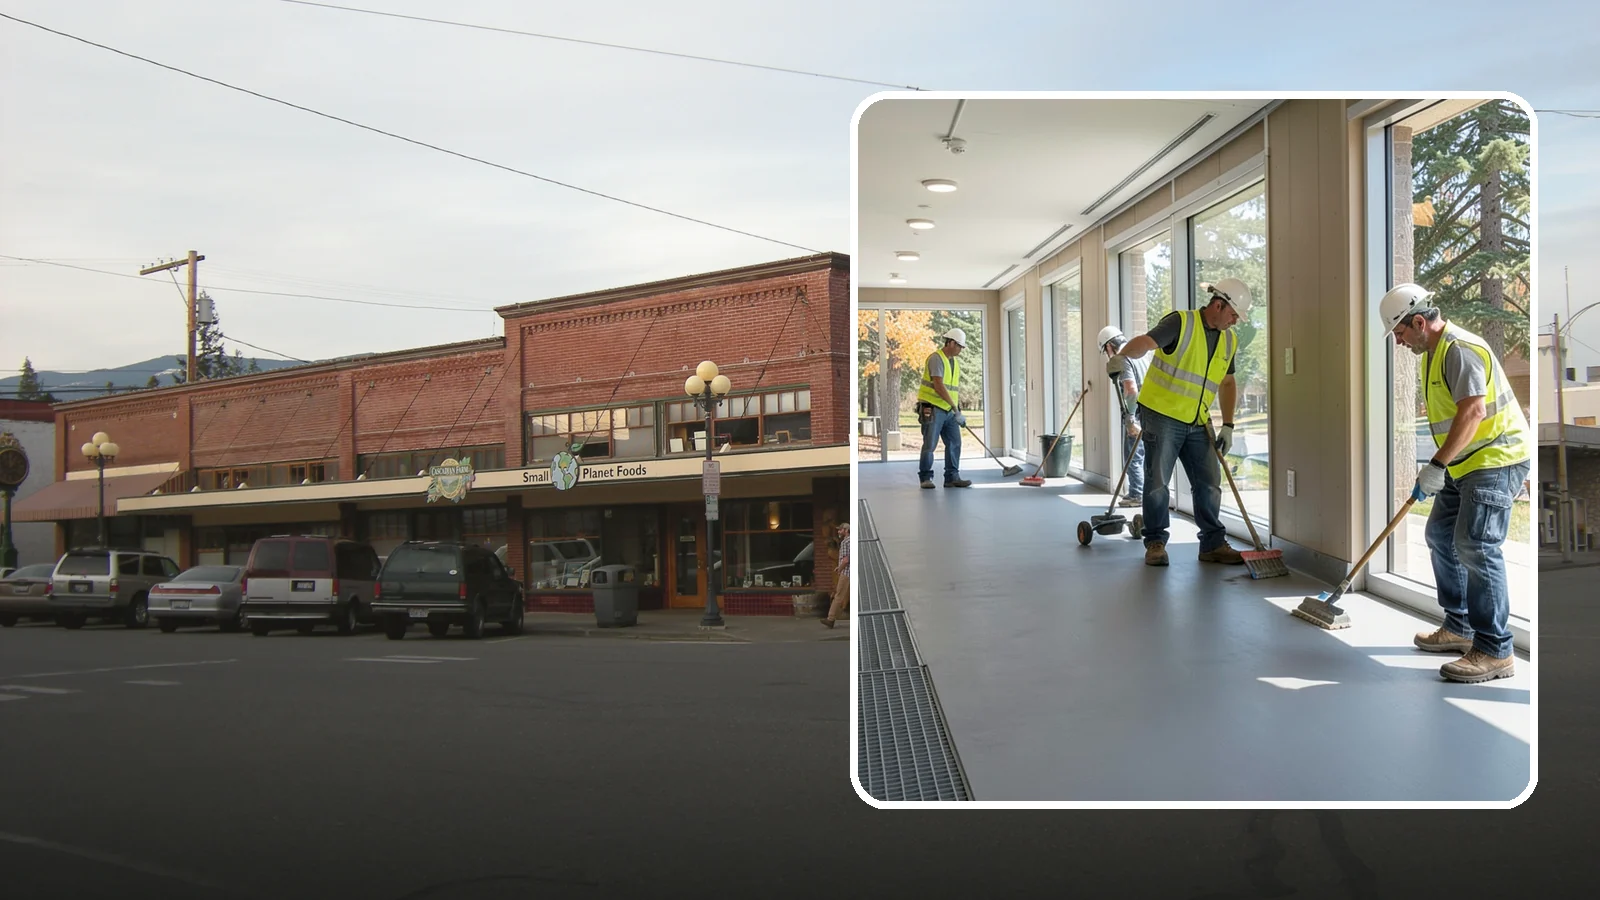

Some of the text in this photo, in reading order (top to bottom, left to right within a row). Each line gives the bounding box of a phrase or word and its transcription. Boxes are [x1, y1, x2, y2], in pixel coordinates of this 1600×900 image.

[523, 464, 647, 483] Small Planet Foods
